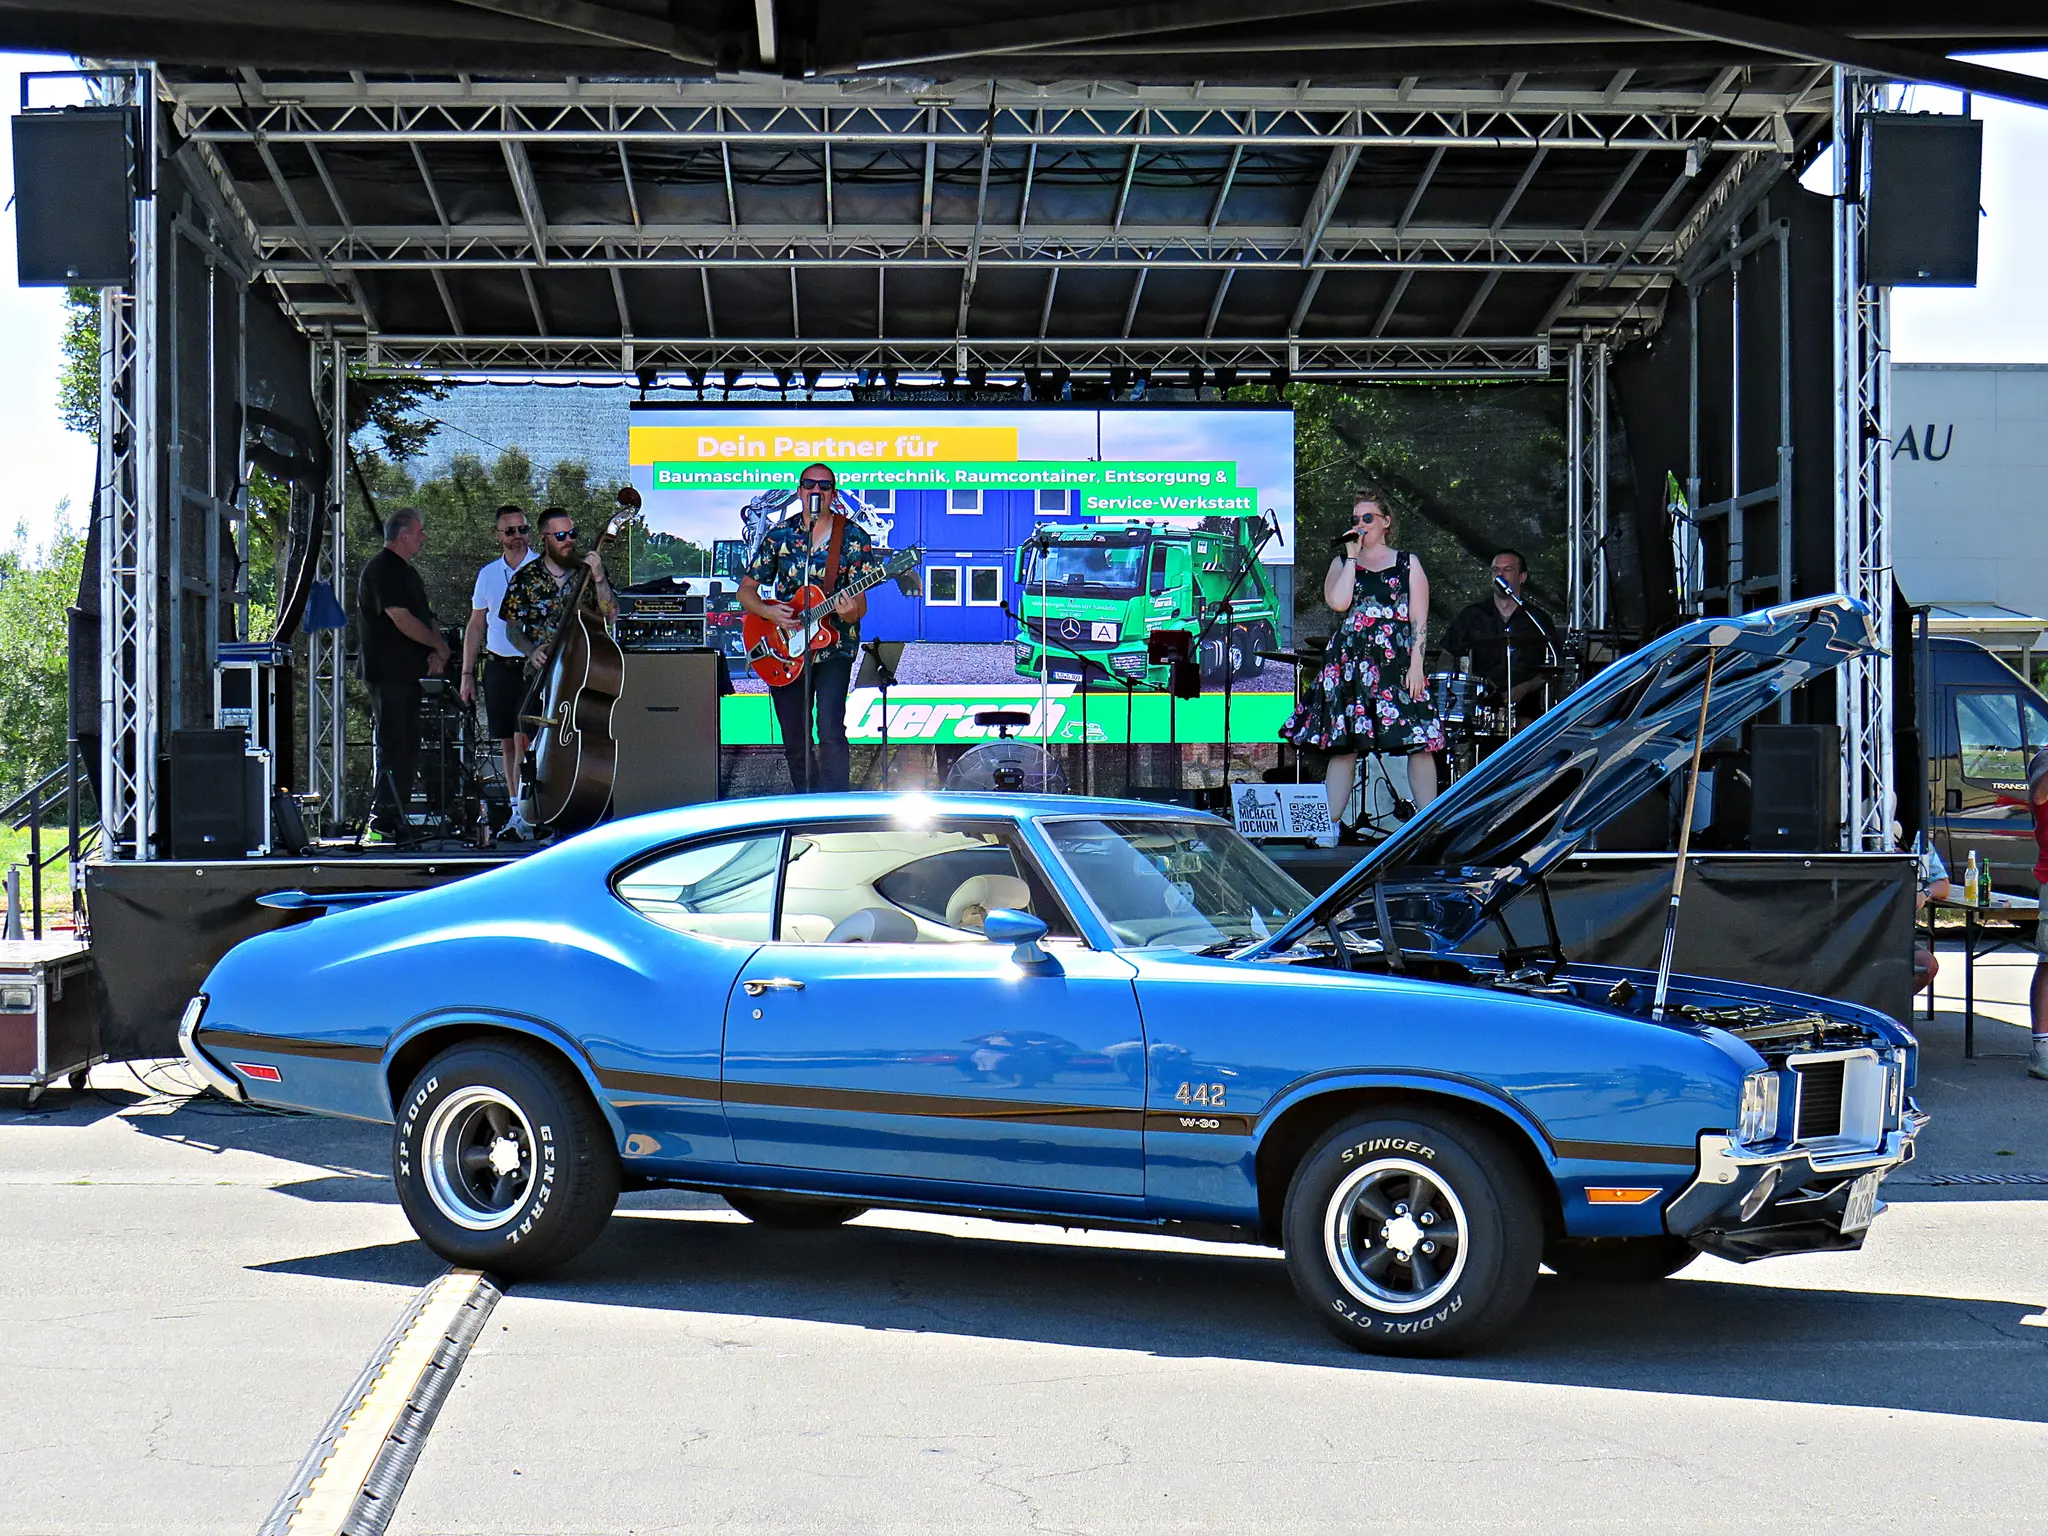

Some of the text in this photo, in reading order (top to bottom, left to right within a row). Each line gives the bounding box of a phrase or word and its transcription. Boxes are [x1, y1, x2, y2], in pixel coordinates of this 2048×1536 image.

[697, 435, 939, 457] Dein Partner für
[659, 469, 799, 485] Baumaschinen,
[955, 469, 1101, 485] Raumcontainer,
[1105, 469, 1211, 486] Entsorgung
[1215, 469, 1228, 483] &
[1087, 495, 1251, 509] Service-Werkstatt
[1097, 625, 1111, 639] A
[1239, 808, 1277, 820] MICHAEL
[1238, 820, 1279, 833] JOCHUM
[1175, 1082, 1227, 1107] 442
[1179, 1118, 1220, 1129] W-30
[1340, 1138, 1436, 1163] STINGER
[506, 1125, 555, 1244] GENERAL
[1331, 1294, 1463, 1334] RADIAL GTS
